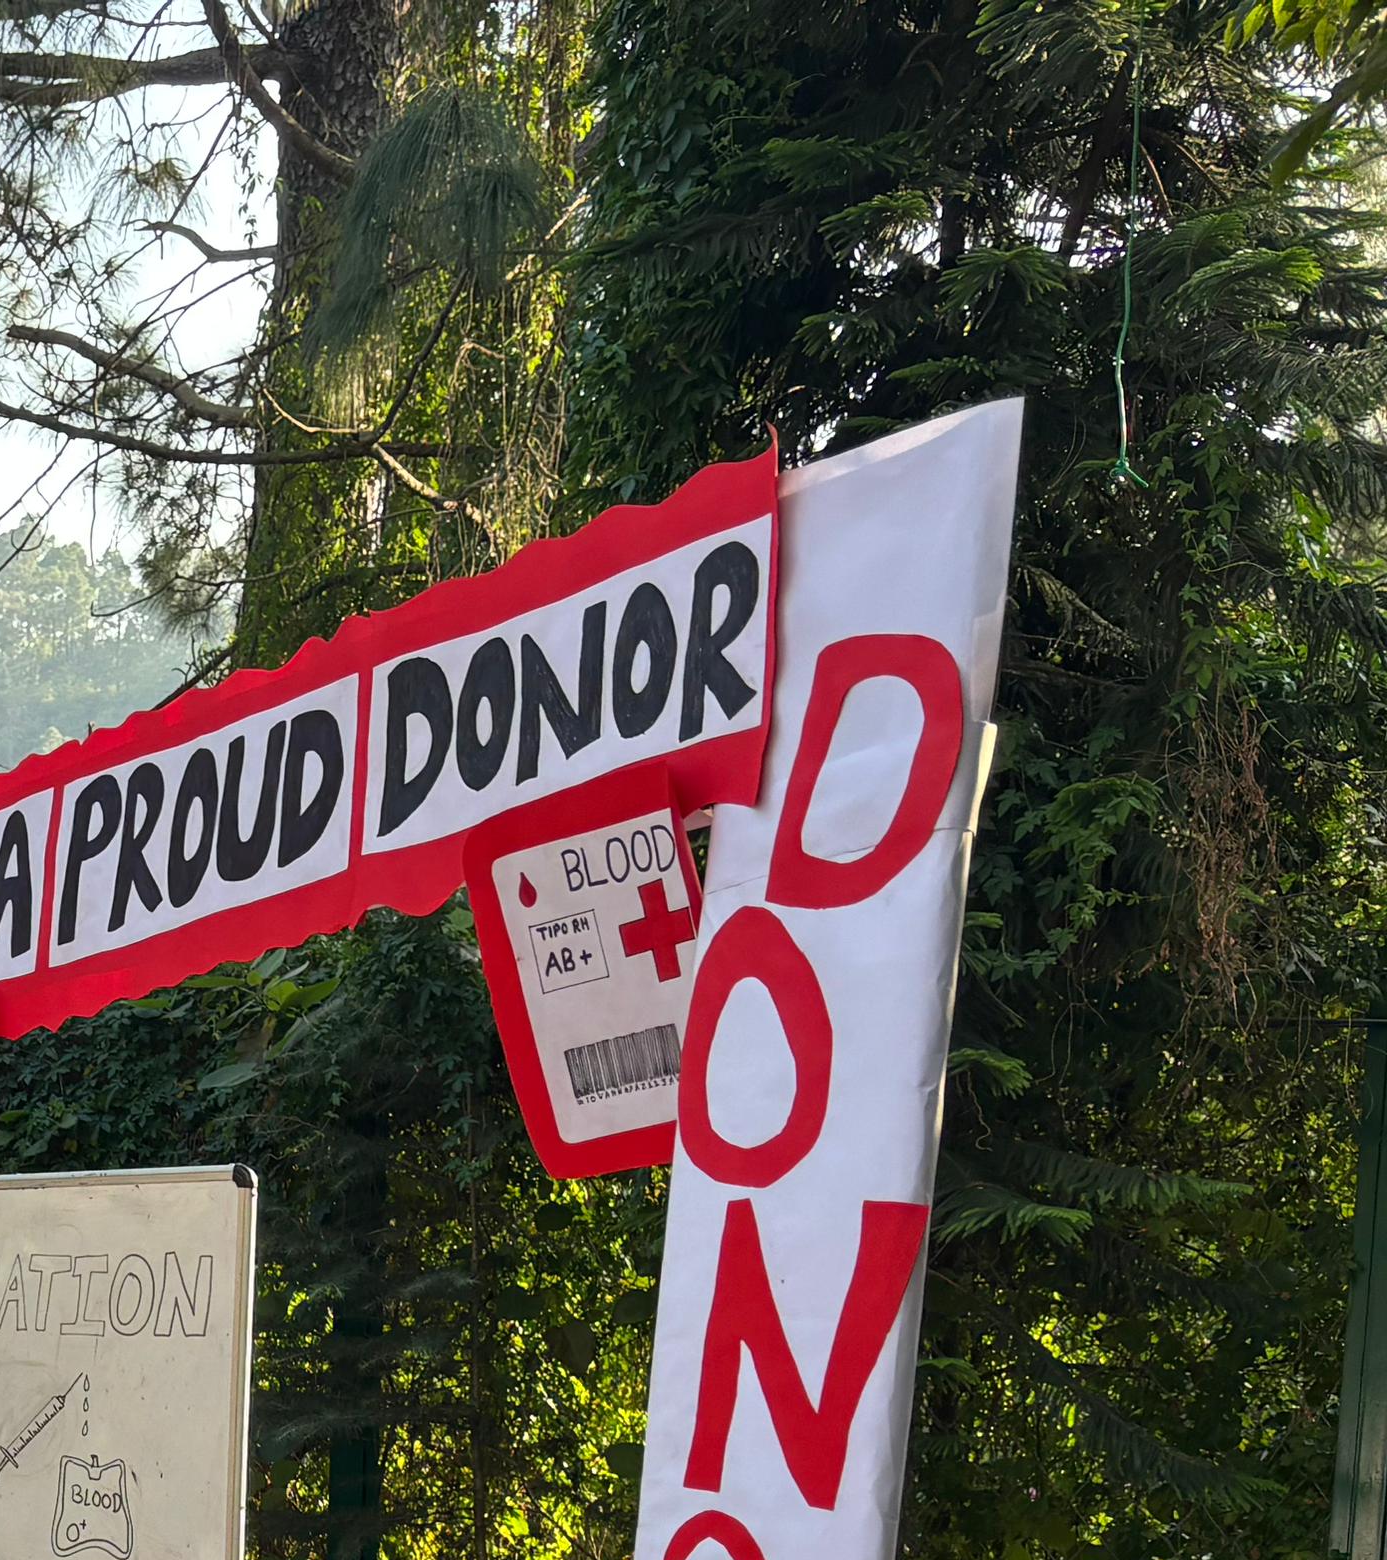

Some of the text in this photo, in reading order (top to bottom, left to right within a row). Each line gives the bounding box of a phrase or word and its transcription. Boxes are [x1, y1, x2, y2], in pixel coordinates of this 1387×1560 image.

[58, 709, 345, 945] PROUD
[377, 540, 762, 838] DONOR
[561, 824, 677, 892] BLOOD
[536, 917, 591, 941] TIPO RH
[71, 1483, 123, 1514] BLOOD
